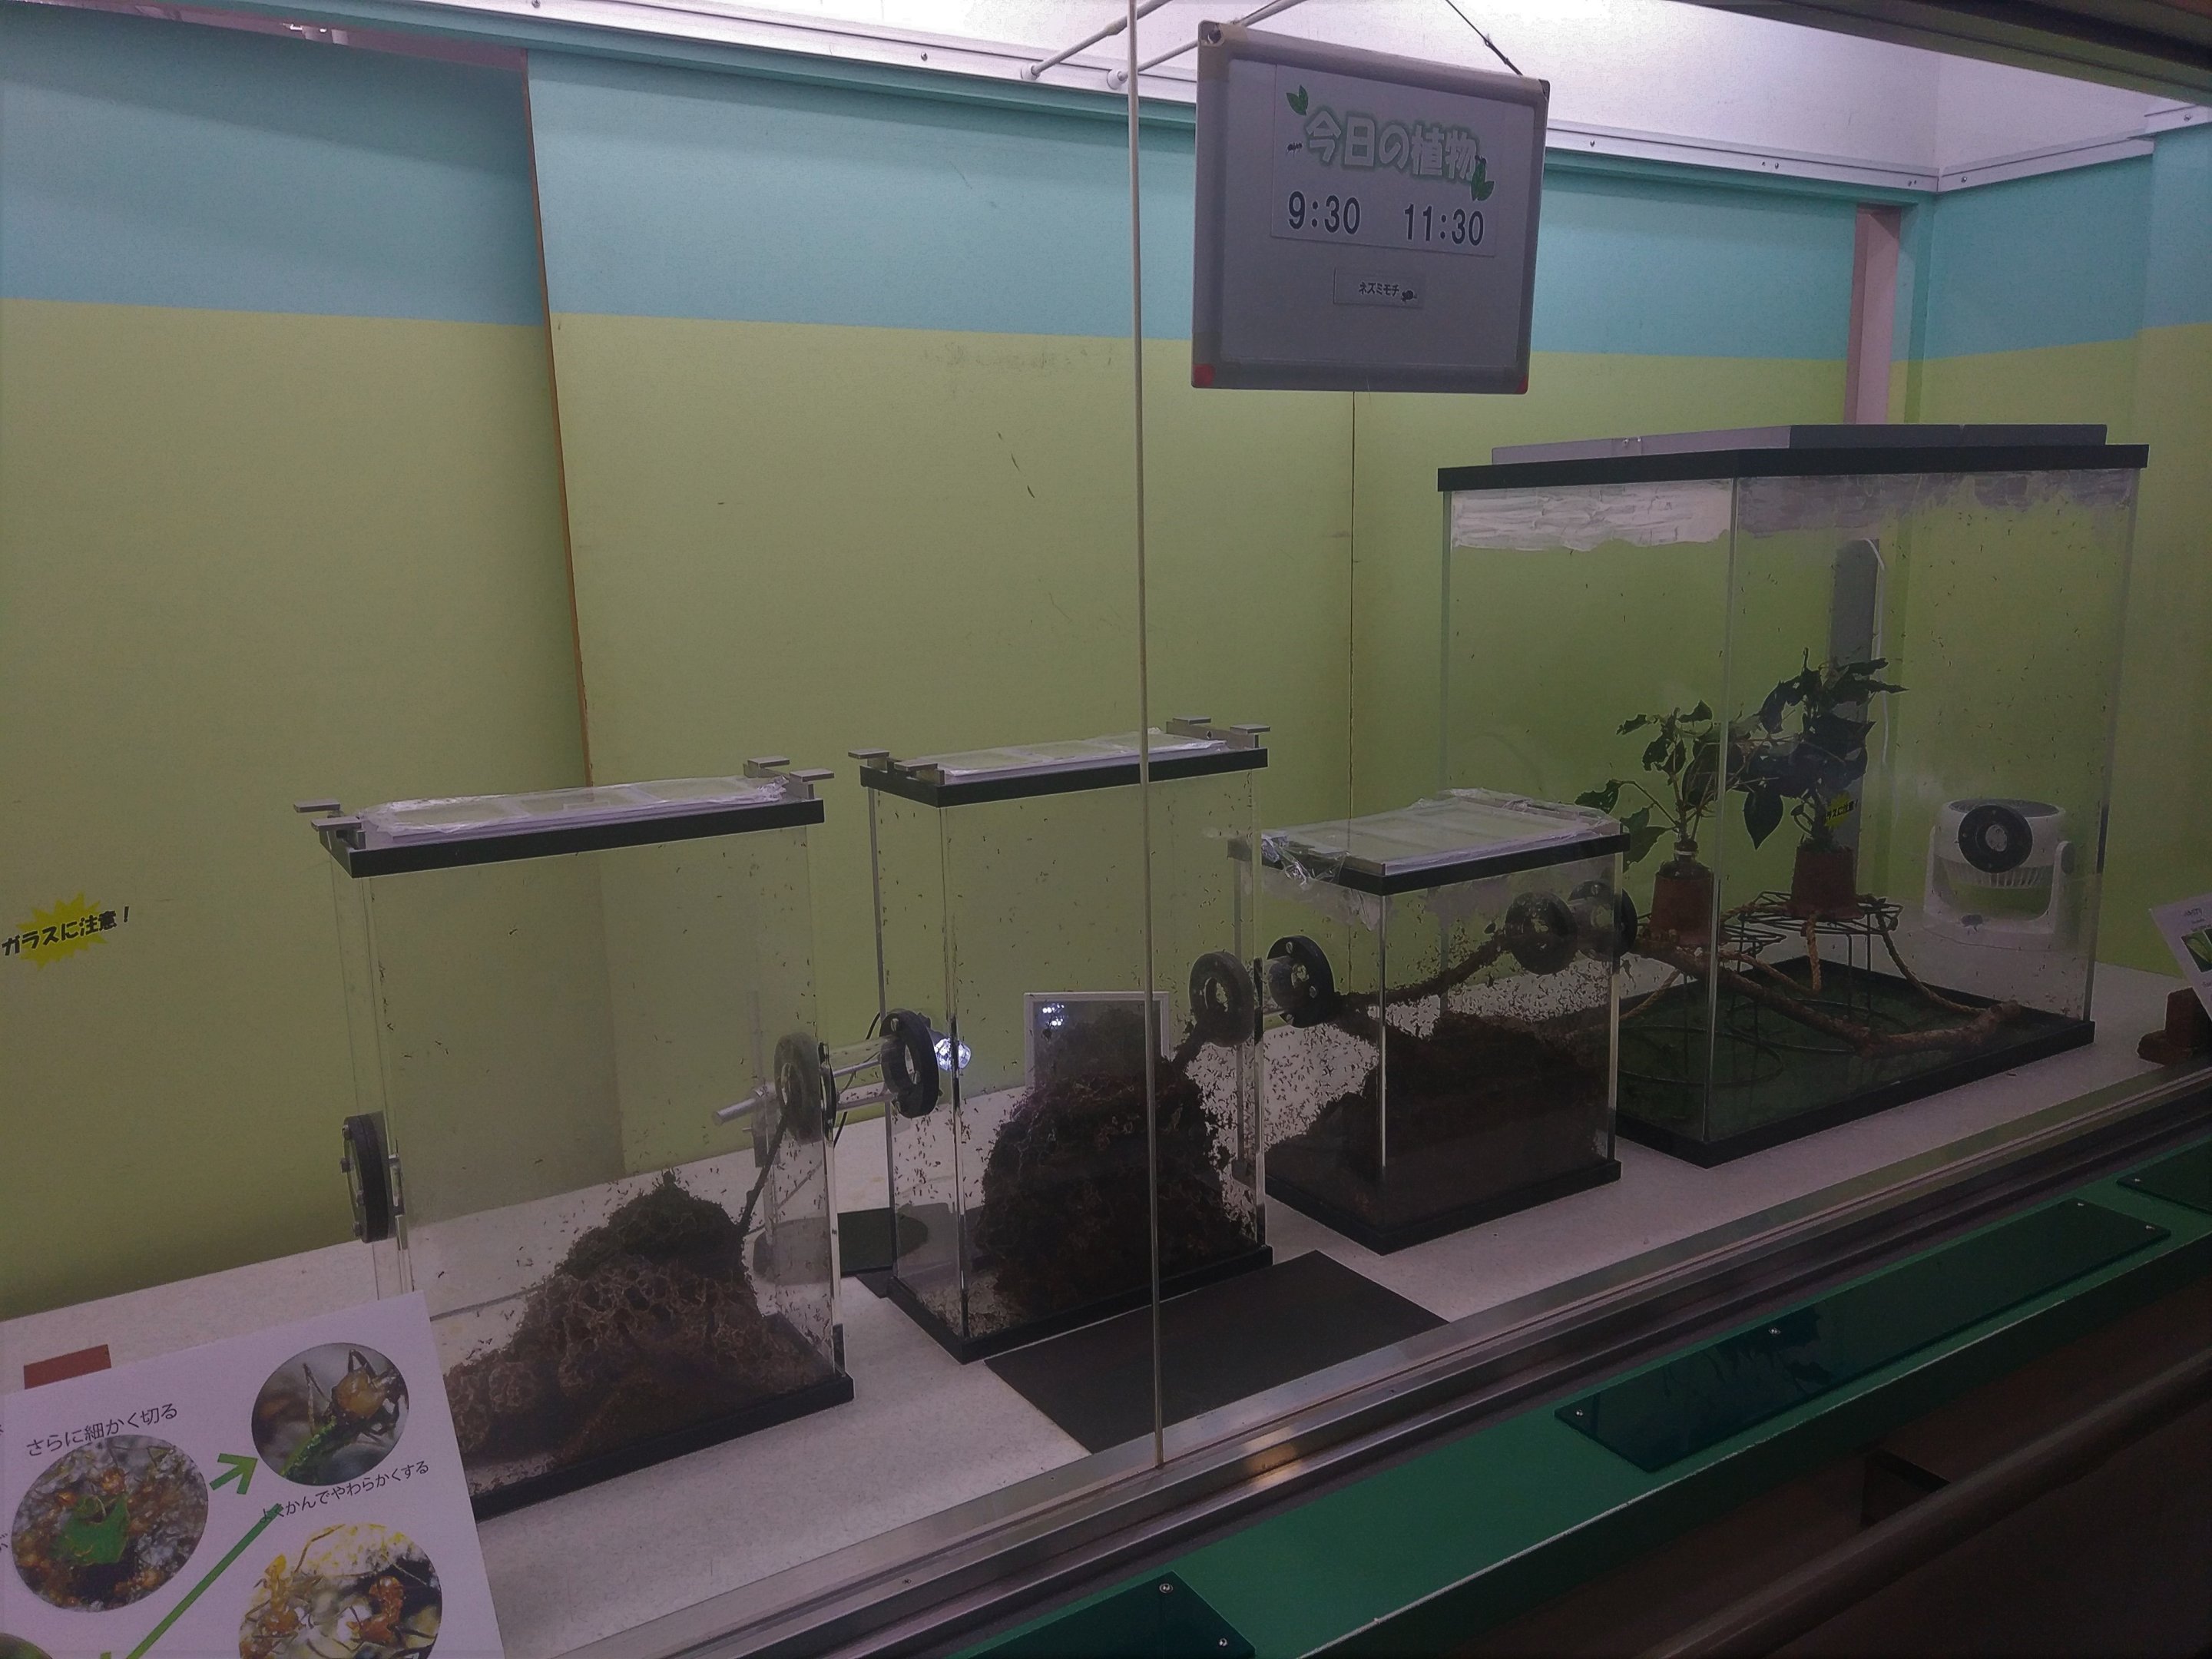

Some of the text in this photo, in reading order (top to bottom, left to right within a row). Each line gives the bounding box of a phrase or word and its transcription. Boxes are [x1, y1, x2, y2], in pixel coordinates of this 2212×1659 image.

[1305, 109, 1477, 182] 今日の植物
[1288, 190, 1484, 247] 9:30 11:30
[1358, 281, 1400, 297] ネズミモチ
[25, 1402, 177, 1457] さらに細かく切る
